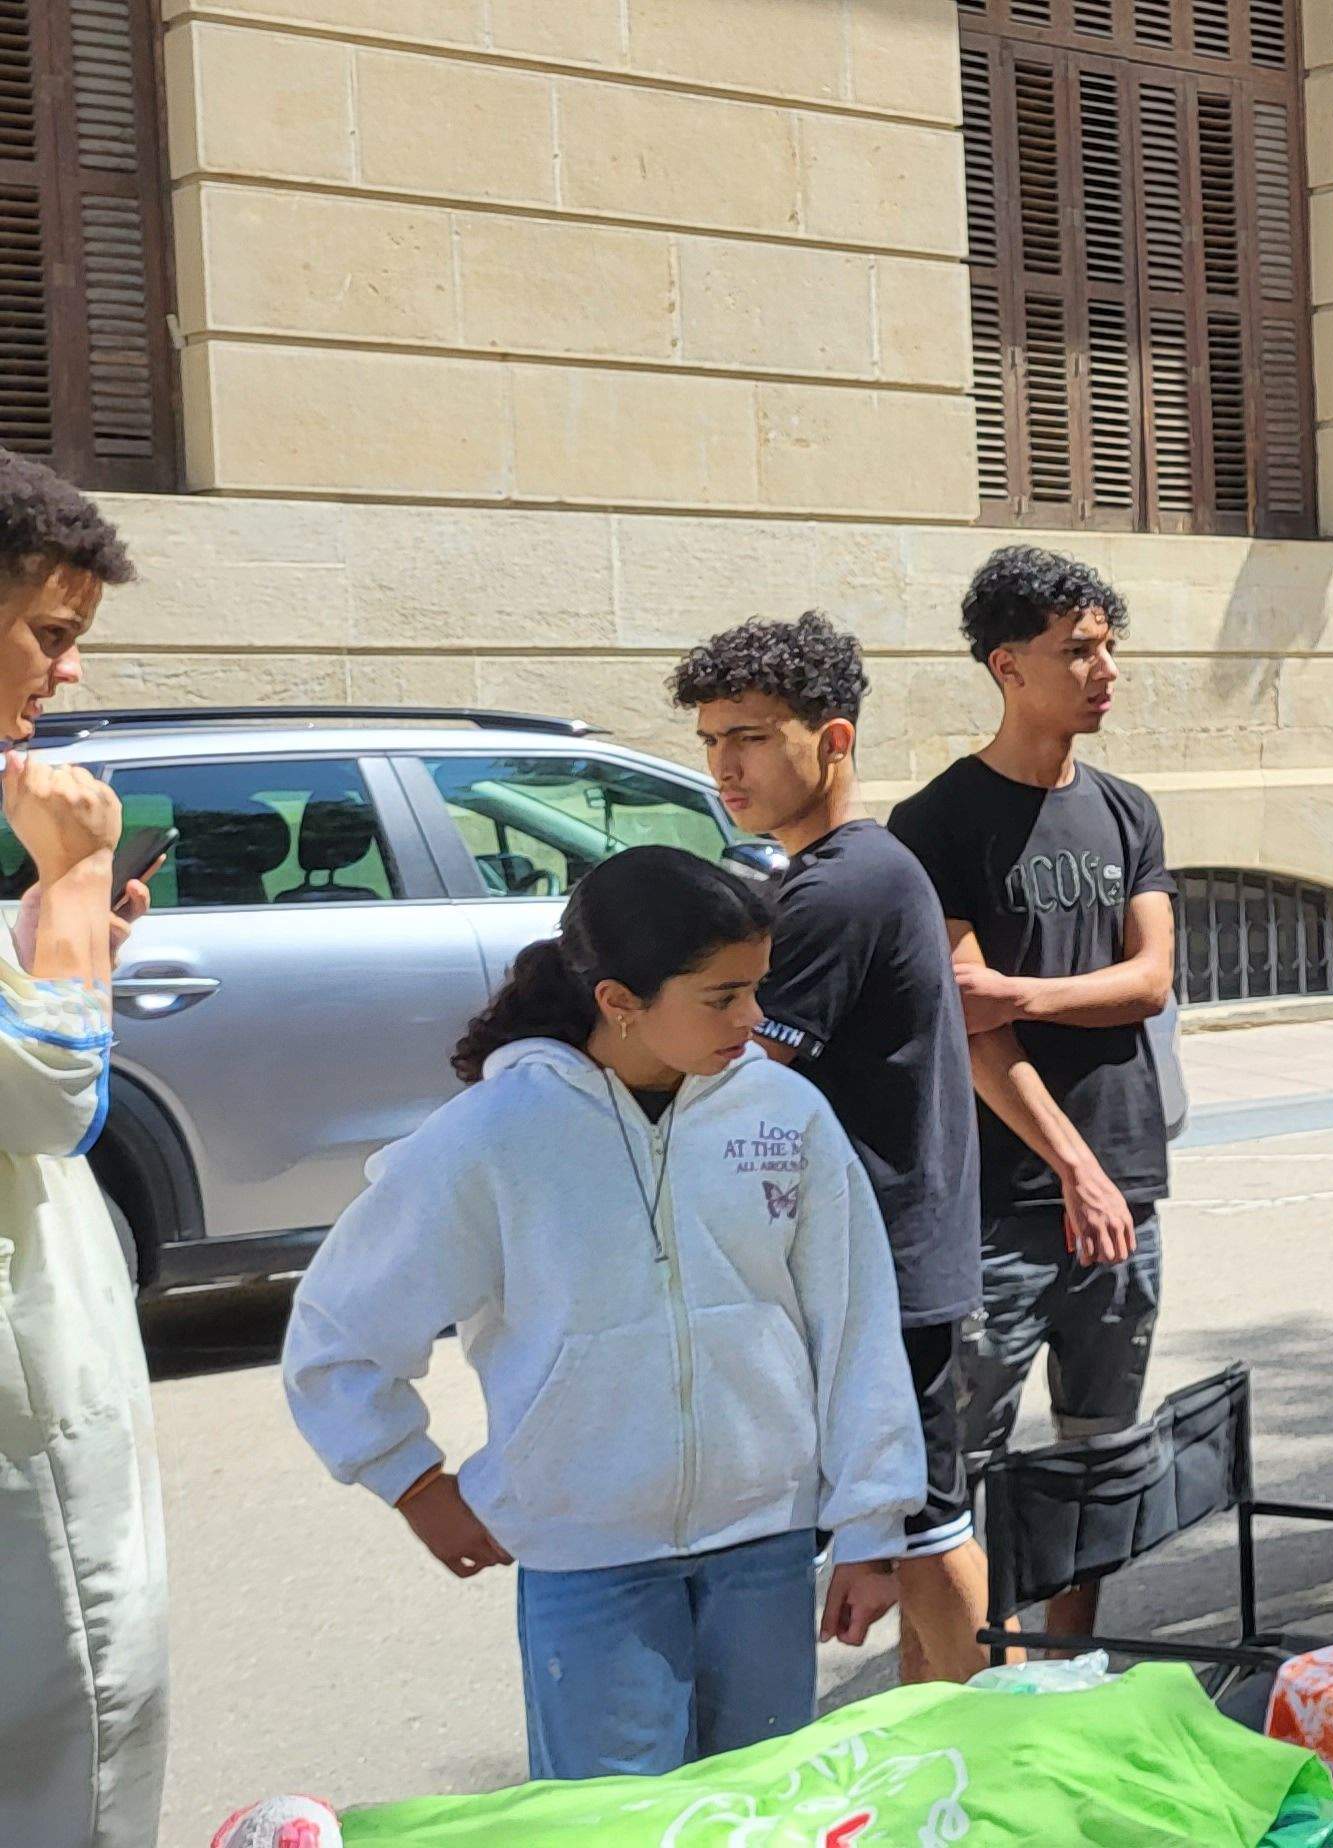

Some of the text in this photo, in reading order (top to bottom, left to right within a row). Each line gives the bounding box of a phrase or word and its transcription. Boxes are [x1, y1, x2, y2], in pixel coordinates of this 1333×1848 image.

[753, 1018, 806, 1048] ENTH
[723, 1139, 746, 1159] AT
[751, 1140, 786, 1157] THE
